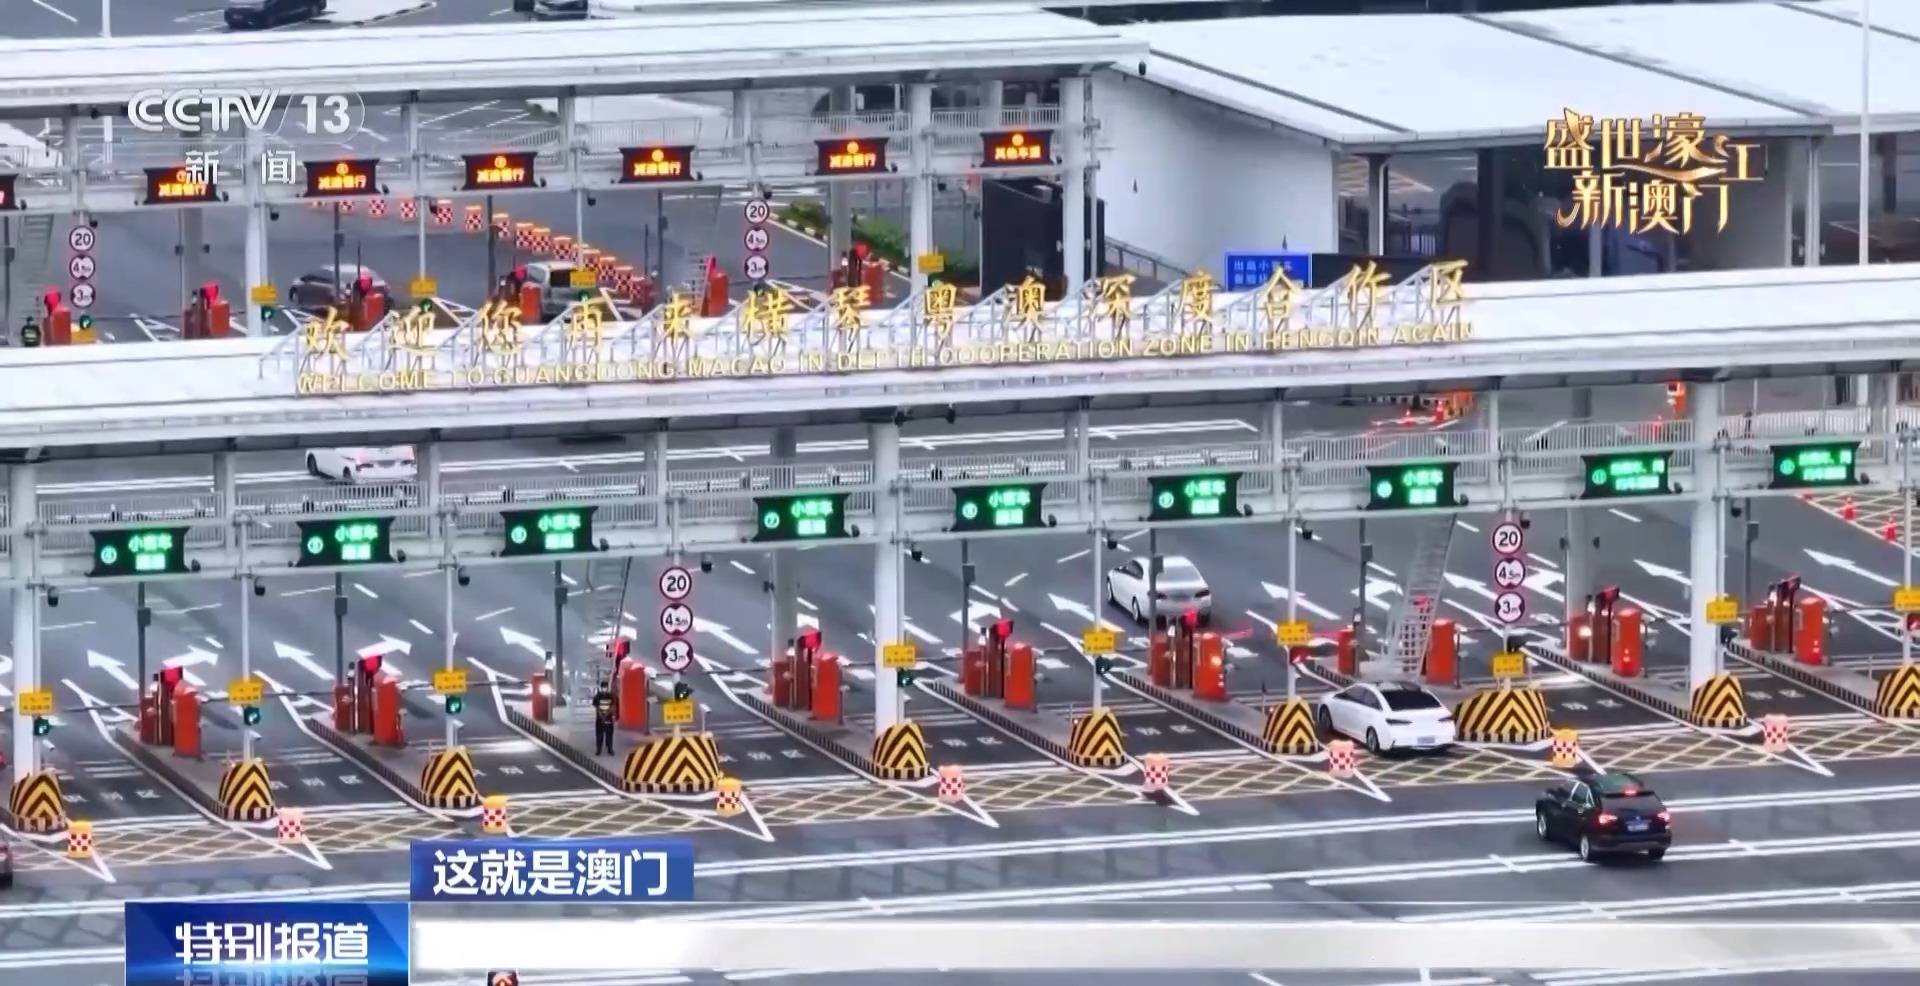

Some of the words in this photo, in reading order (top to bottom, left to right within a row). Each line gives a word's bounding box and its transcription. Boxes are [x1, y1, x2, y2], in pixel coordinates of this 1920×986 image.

[750, 205, 765, 218] 20
[75, 233, 91, 246] 20
[298, 370, 433, 394] WELCOME
[452, 366, 485, 387] TO
[939, 338, 1133, 366] COOPERATION
[1143, 334, 1213, 357] ZONE
[1226, 333, 1250, 352] IN
[1261, 327, 1381, 351] HENGQIN
[1393, 322, 1474, 344] AGAIN
[1498, 531, 1518, 547] 20
[666, 575, 687, 592] 20
[669, 648, 686, 662] 3m
